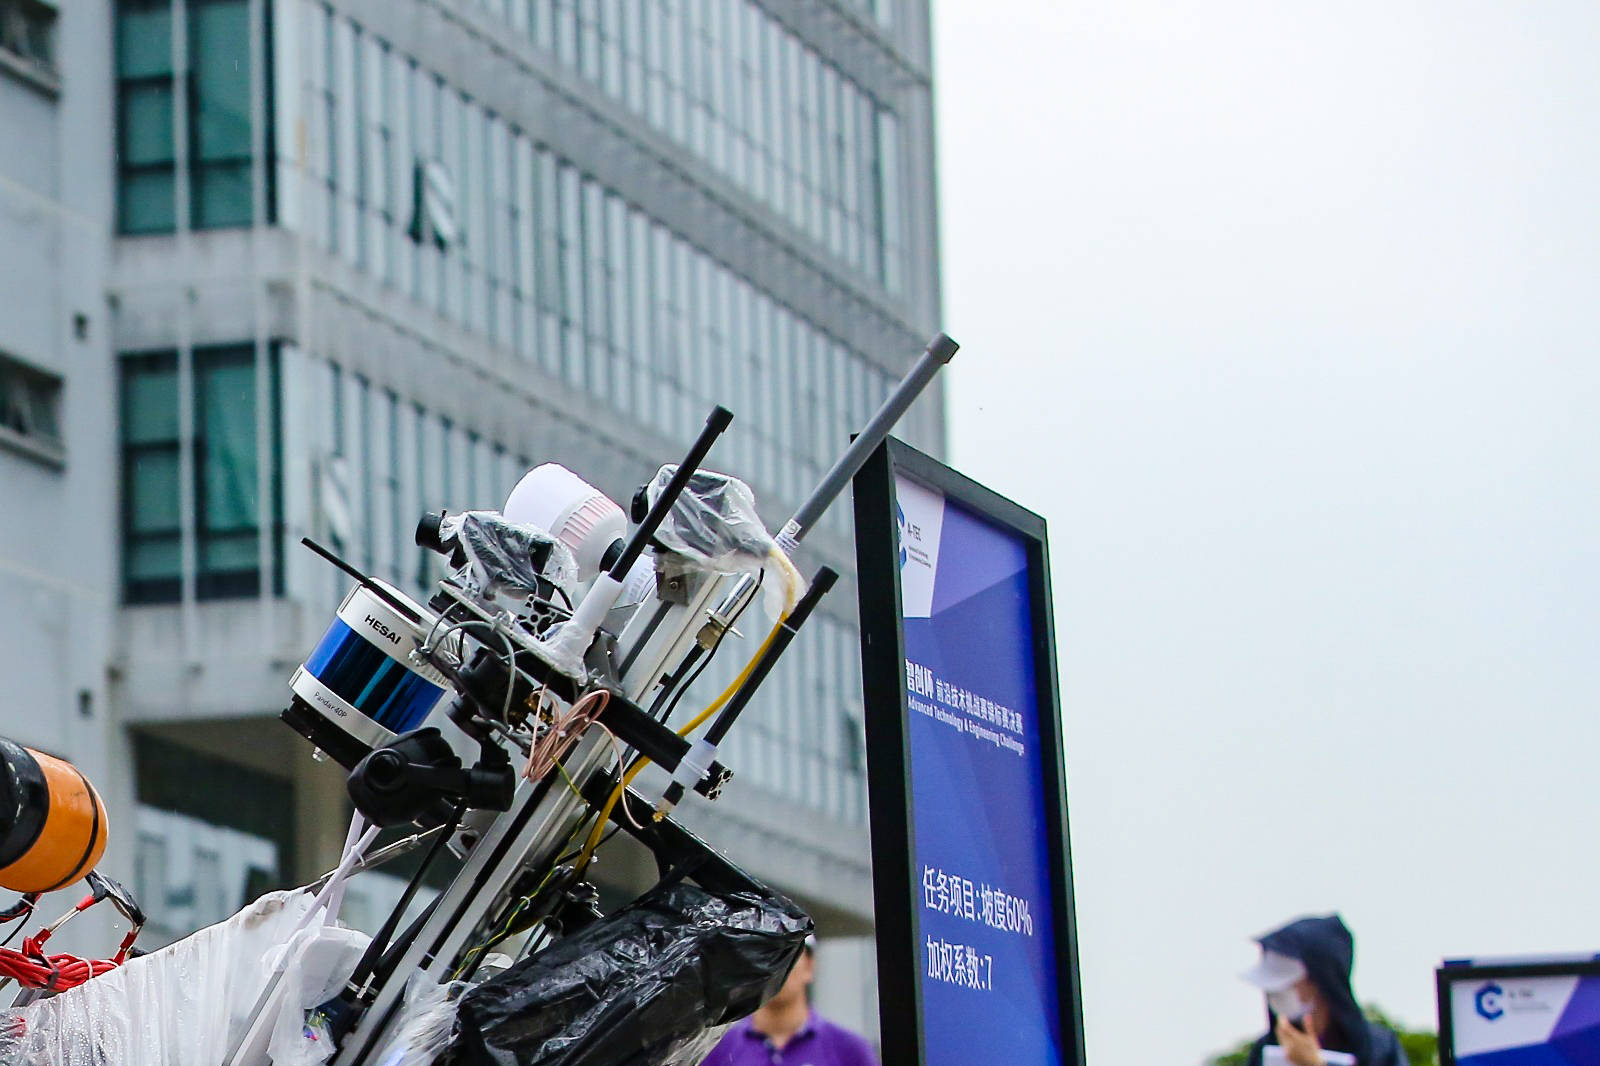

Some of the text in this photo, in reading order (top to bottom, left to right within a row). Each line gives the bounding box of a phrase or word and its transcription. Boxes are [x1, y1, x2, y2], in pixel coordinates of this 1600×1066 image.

[364, 614, 402, 645] HESAI
[922, 864, 1033, 937] 任务项目:坡度60%
[926, 934, 993, 991] 加权系数:7
